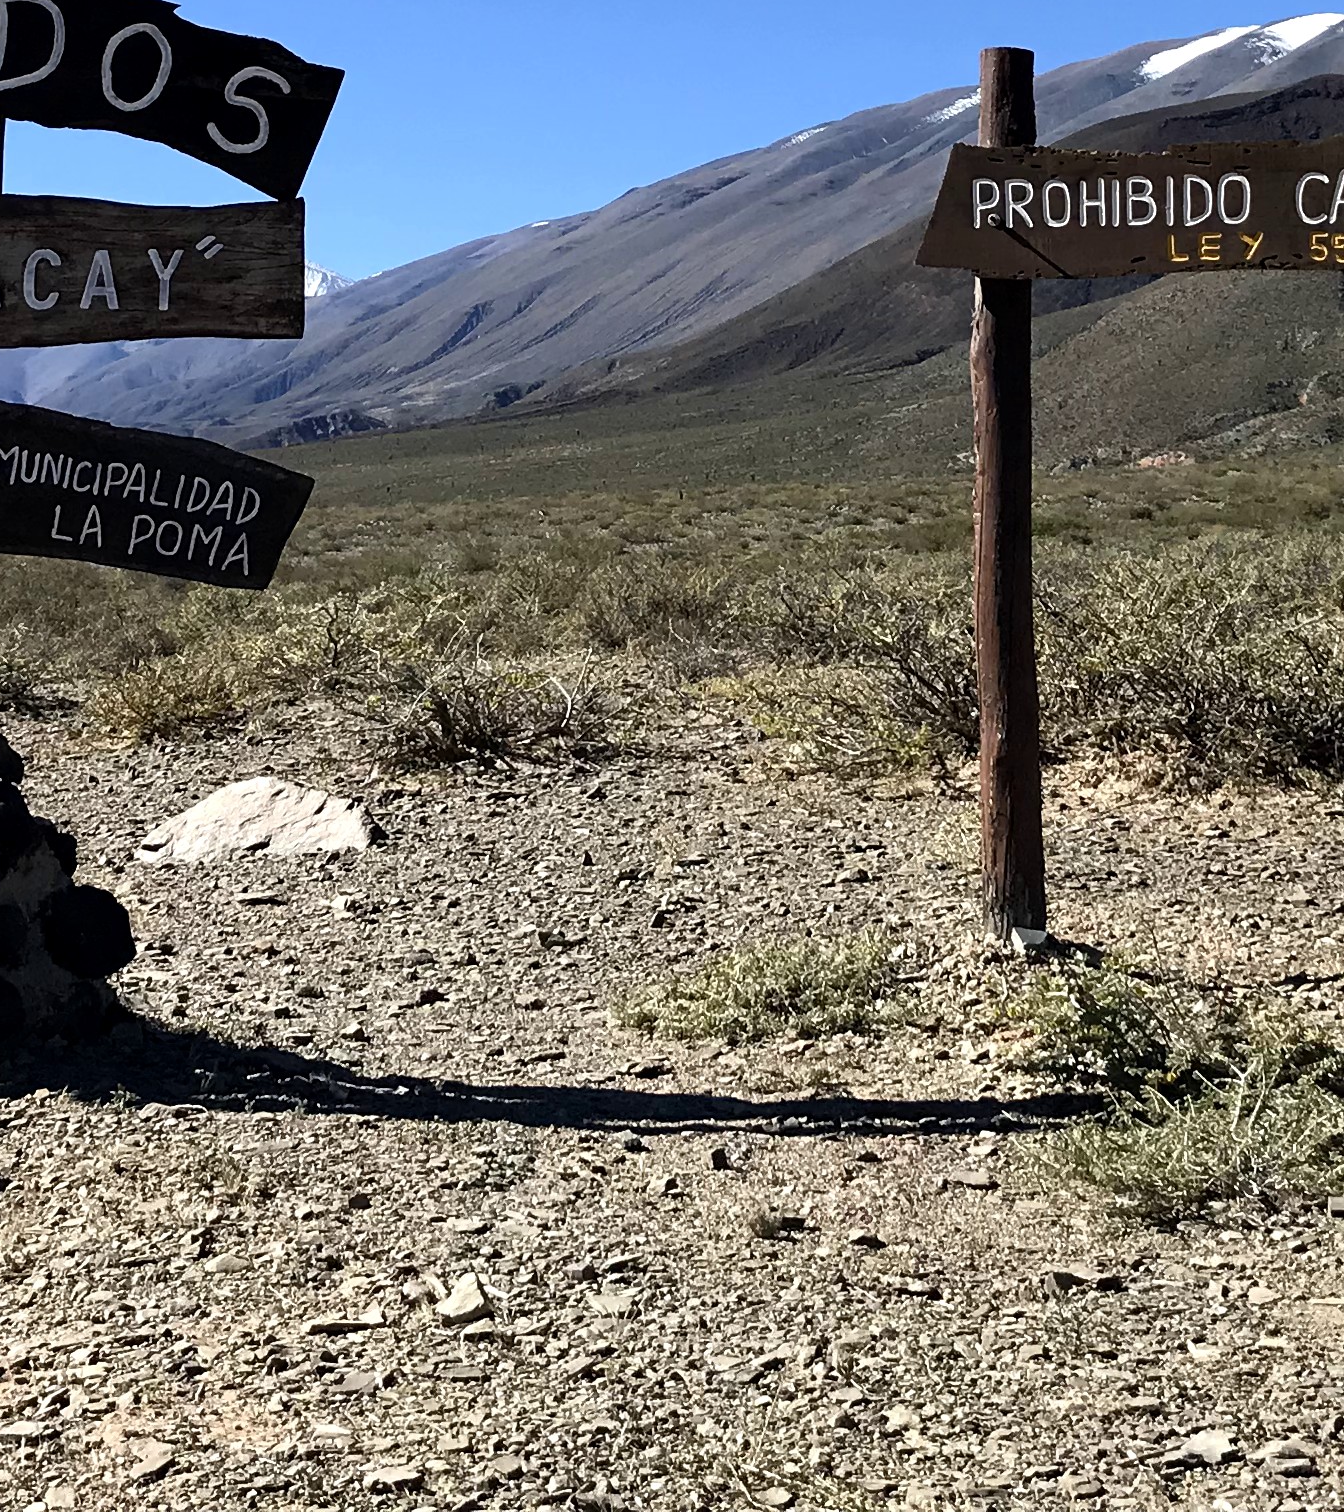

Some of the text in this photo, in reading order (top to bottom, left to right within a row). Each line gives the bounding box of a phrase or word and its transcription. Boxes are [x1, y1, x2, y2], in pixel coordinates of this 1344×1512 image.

[972, 171, 1252, 230] PROHIBIDO
[1166, 231, 1265, 263] LEY
[50, 504, 250, 576] LA POMA
